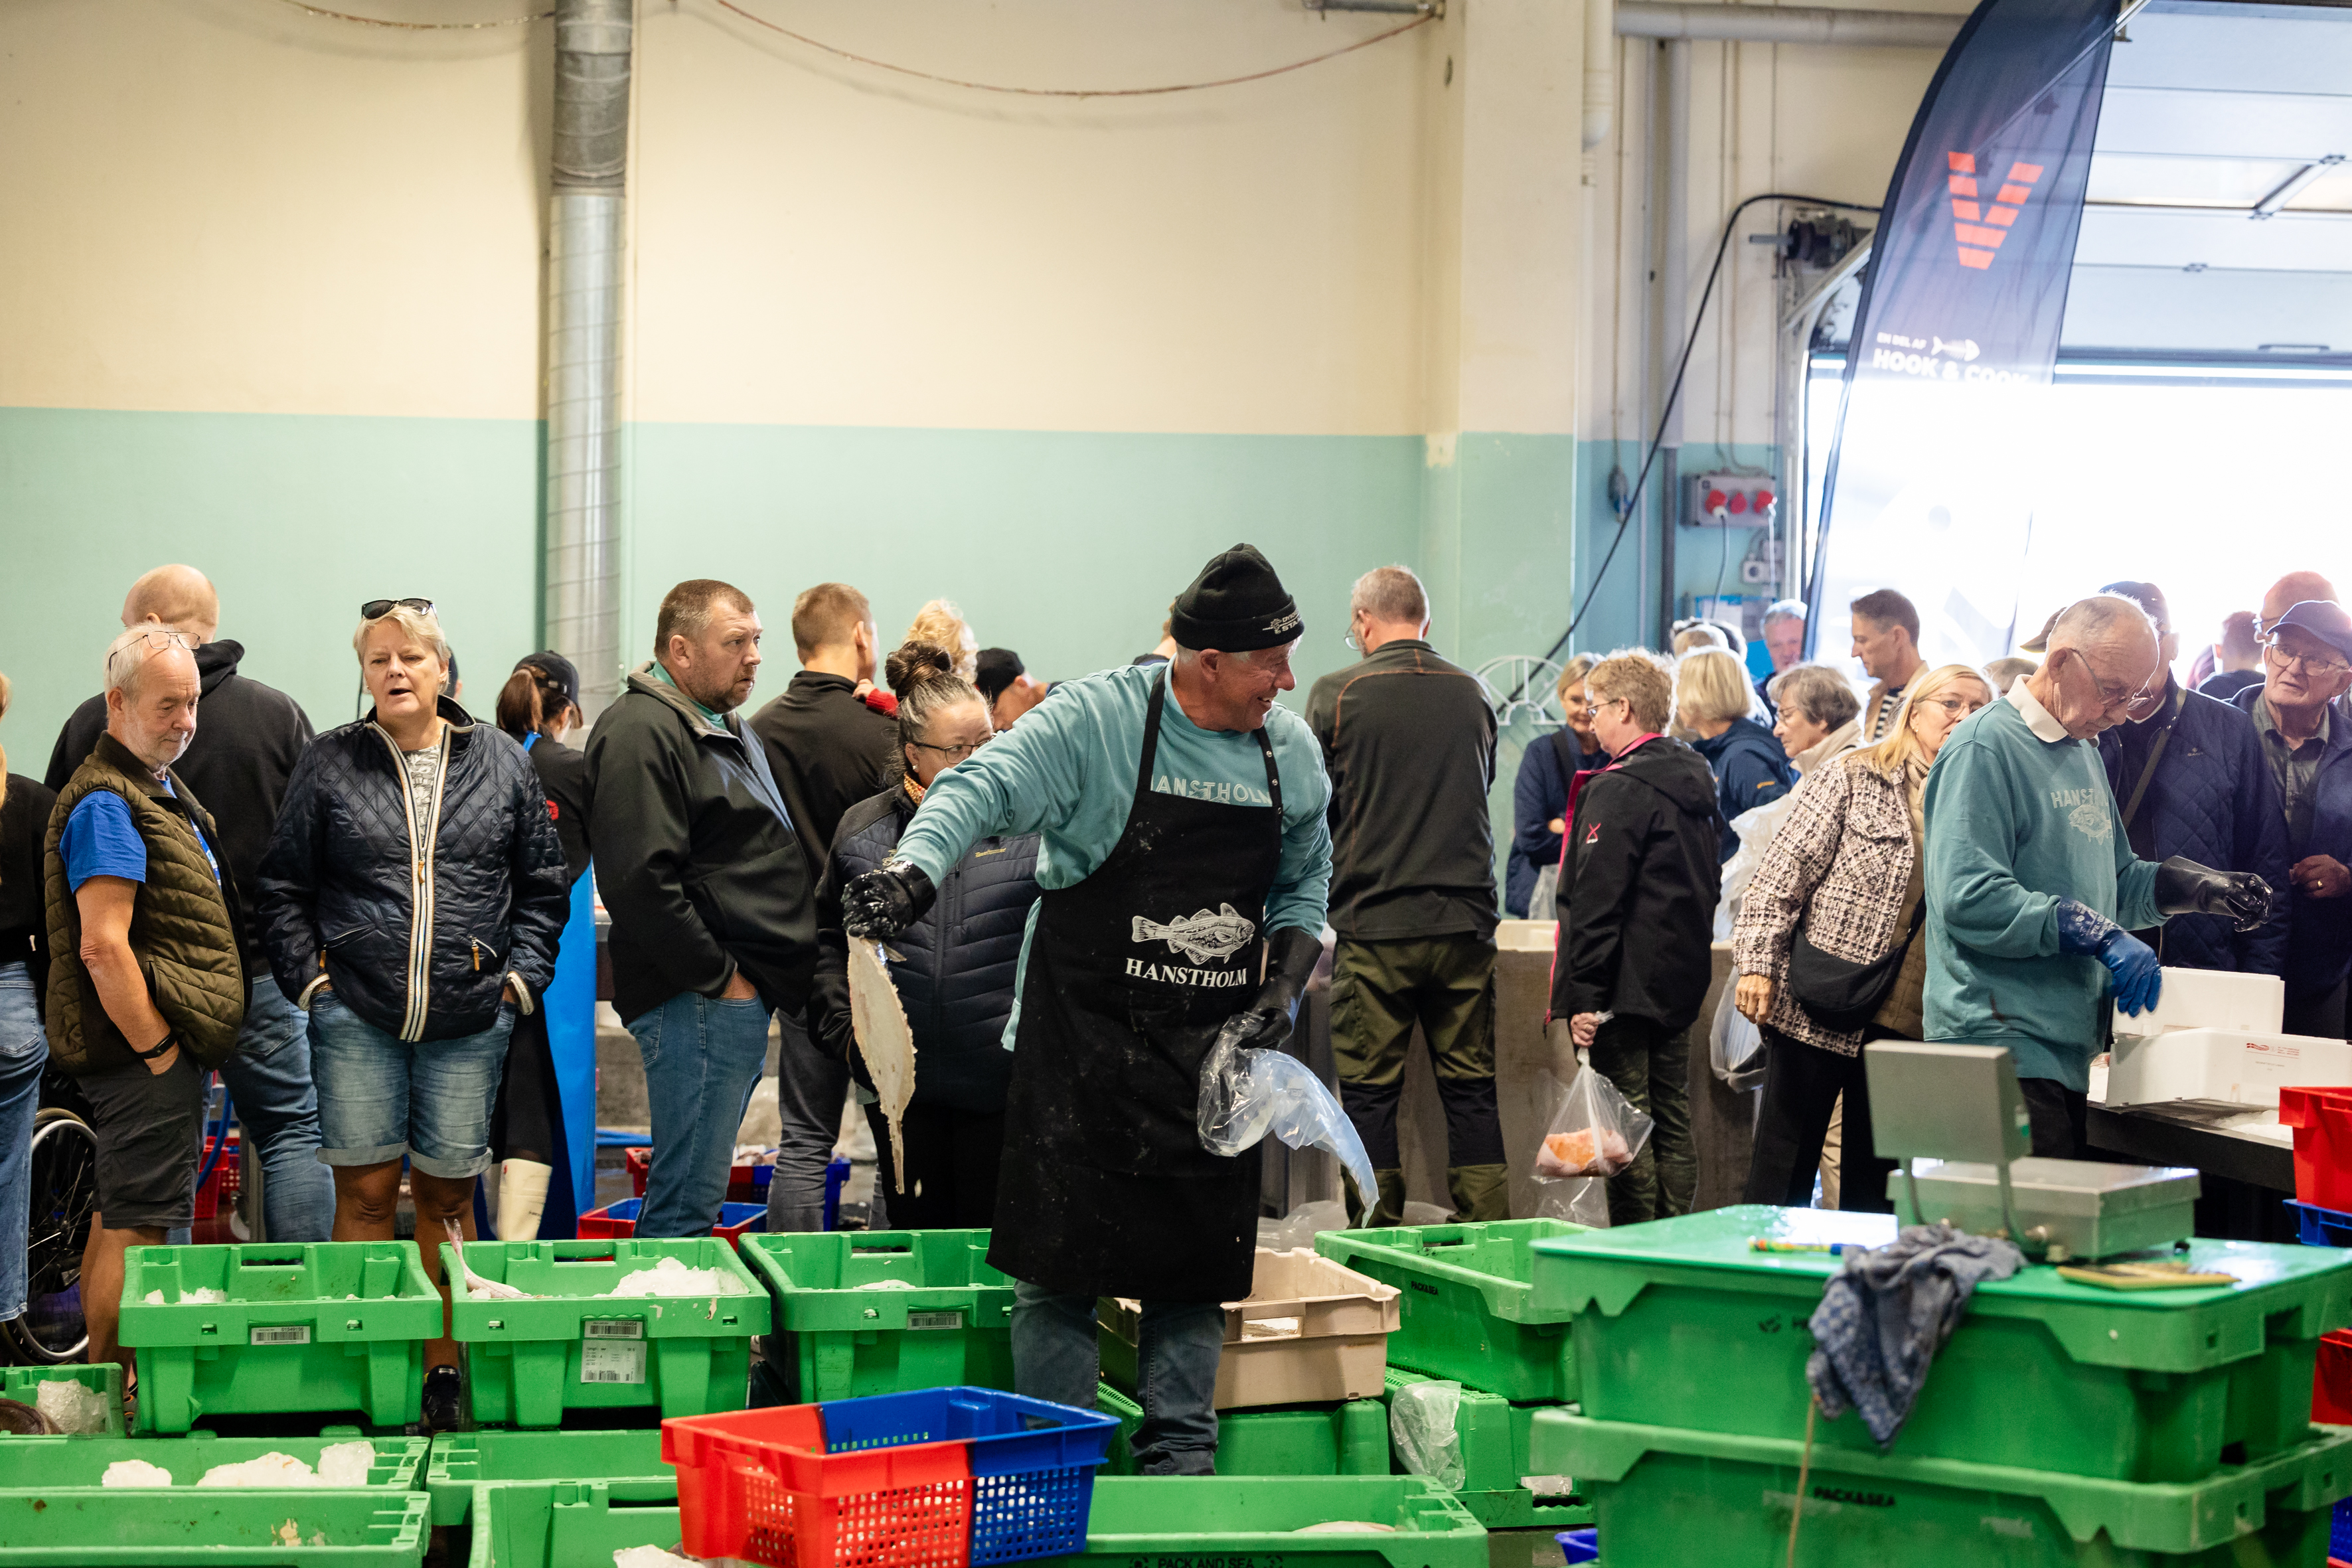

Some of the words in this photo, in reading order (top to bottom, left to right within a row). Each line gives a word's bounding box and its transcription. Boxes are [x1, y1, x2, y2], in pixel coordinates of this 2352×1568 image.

[1872, 348, 1939, 378] HOOK
[1150, 774, 1273, 805] ANSTHOLM
[1125, 957, 1247, 988] HANSTHOLM
[1158, 1557, 1193, 1568] PACK
[1196, 1557, 1225, 1568] AND
[1228, 1557, 1254, 1568] SEA
